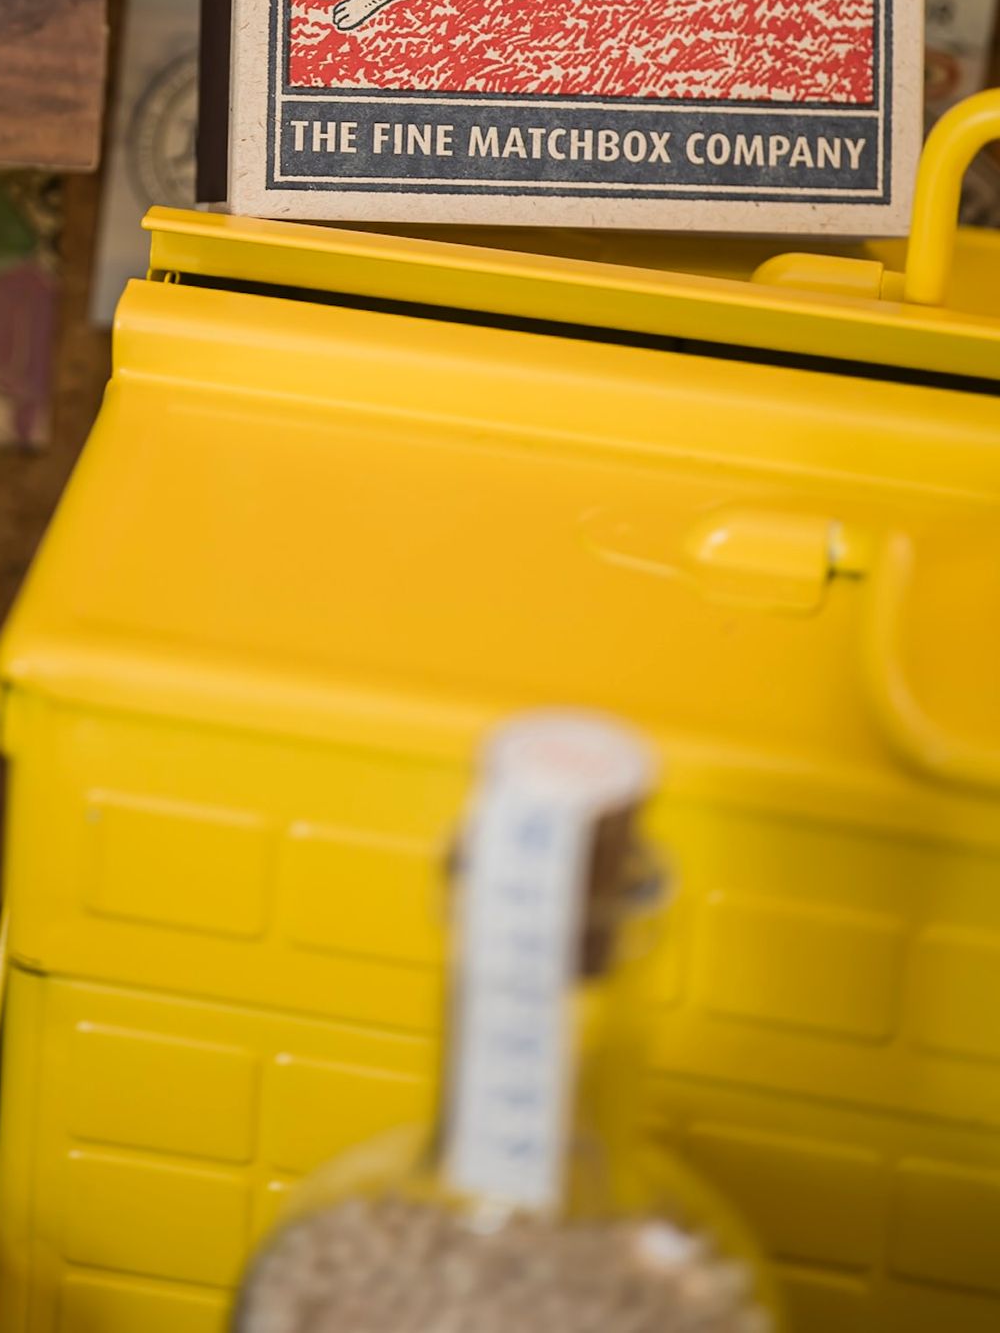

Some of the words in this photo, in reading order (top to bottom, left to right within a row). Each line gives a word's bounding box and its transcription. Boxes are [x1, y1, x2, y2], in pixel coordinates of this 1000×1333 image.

[290, 120, 359, 155] THE
[371, 122, 455, 158] FINE
[467, 124, 672, 165] MATCHBOX
[685, 131, 867, 170] COMPANY
